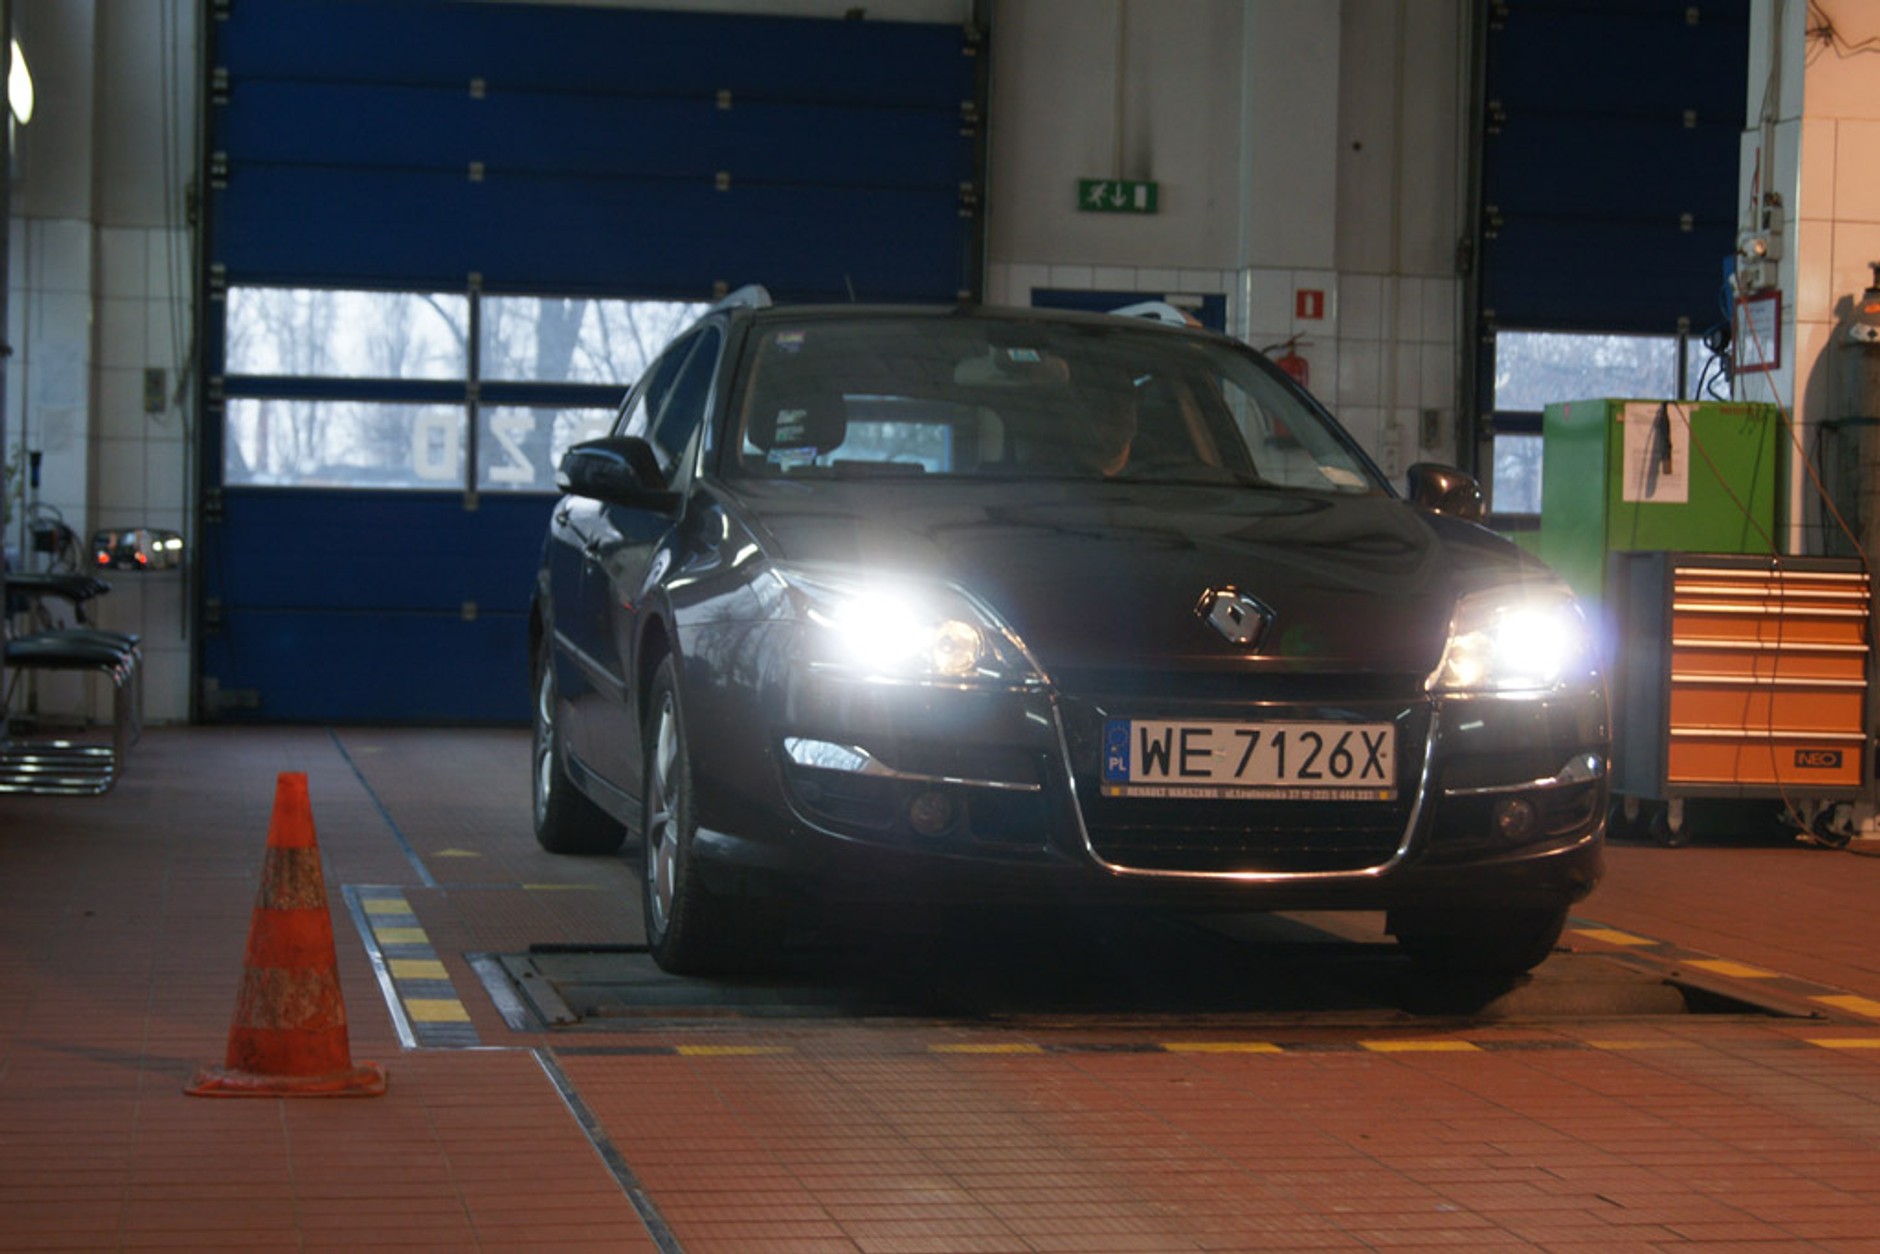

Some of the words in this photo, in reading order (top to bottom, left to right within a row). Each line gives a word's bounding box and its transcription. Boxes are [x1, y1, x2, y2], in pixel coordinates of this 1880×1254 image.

[1139, 727, 1213, 778] WE
[1233, 729, 1387, 780] 7126X
[1798, 752, 1837, 767] NEO
[1108, 756, 1127, 772] PL
